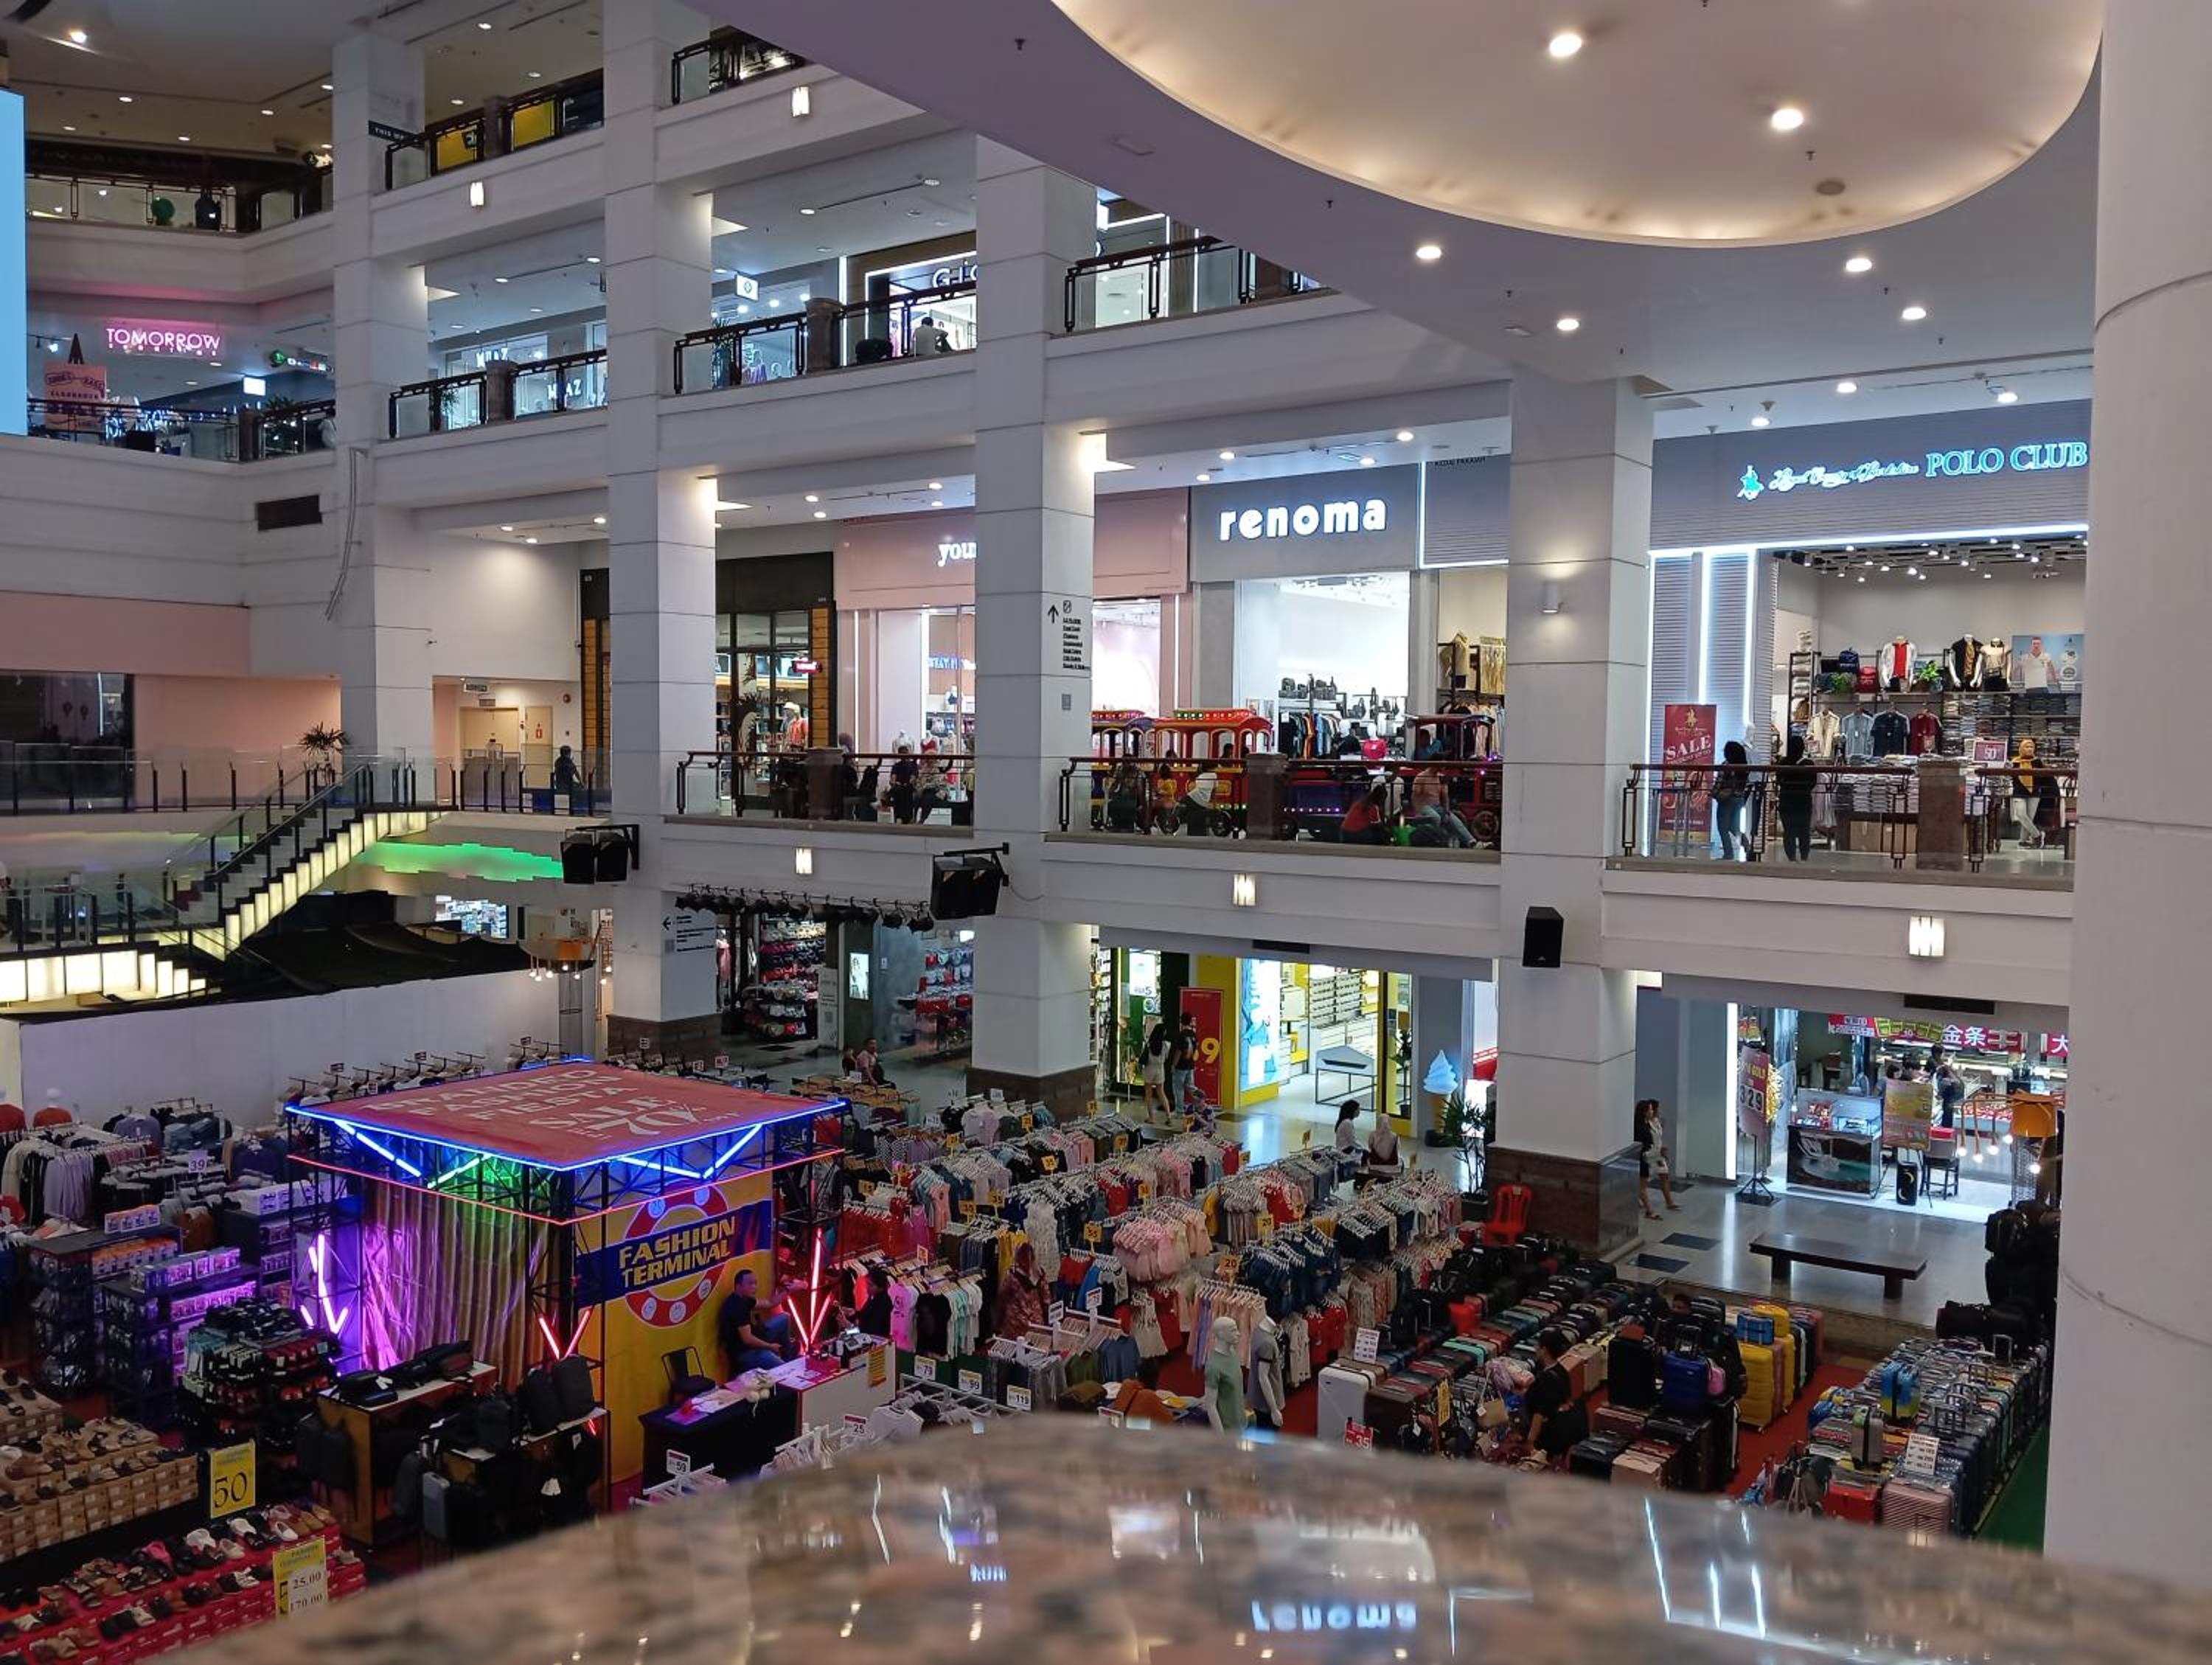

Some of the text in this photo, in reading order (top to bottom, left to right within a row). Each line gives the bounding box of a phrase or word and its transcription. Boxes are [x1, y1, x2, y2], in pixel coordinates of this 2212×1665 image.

[106, 329, 220, 351] TOMORROW
[548, 378, 582, 400] MAZ
[1926, 448, 2005, 478] POLO
[2010, 442, 2088, 473] CLUB
[1220, 498, 1387, 541] renoma
[1666, 735, 1711, 761] SALE
[409, 1074, 624, 1116] FASHION
[470, 1085, 639, 1120] FIESTA
[529, 1096, 677, 1129] SALE
[190, 1159, 206, 1172] 39
[619, 1216, 735, 1269] FASHION
[622, 1240, 731, 1288] TERMINAL
[1225, 1258, 1237, 1268] 20
[1356, 1434, 1370, 1450] 35
[214, 1472, 247, 1509] 50
[293, 1571, 322, 1590] 25.00
